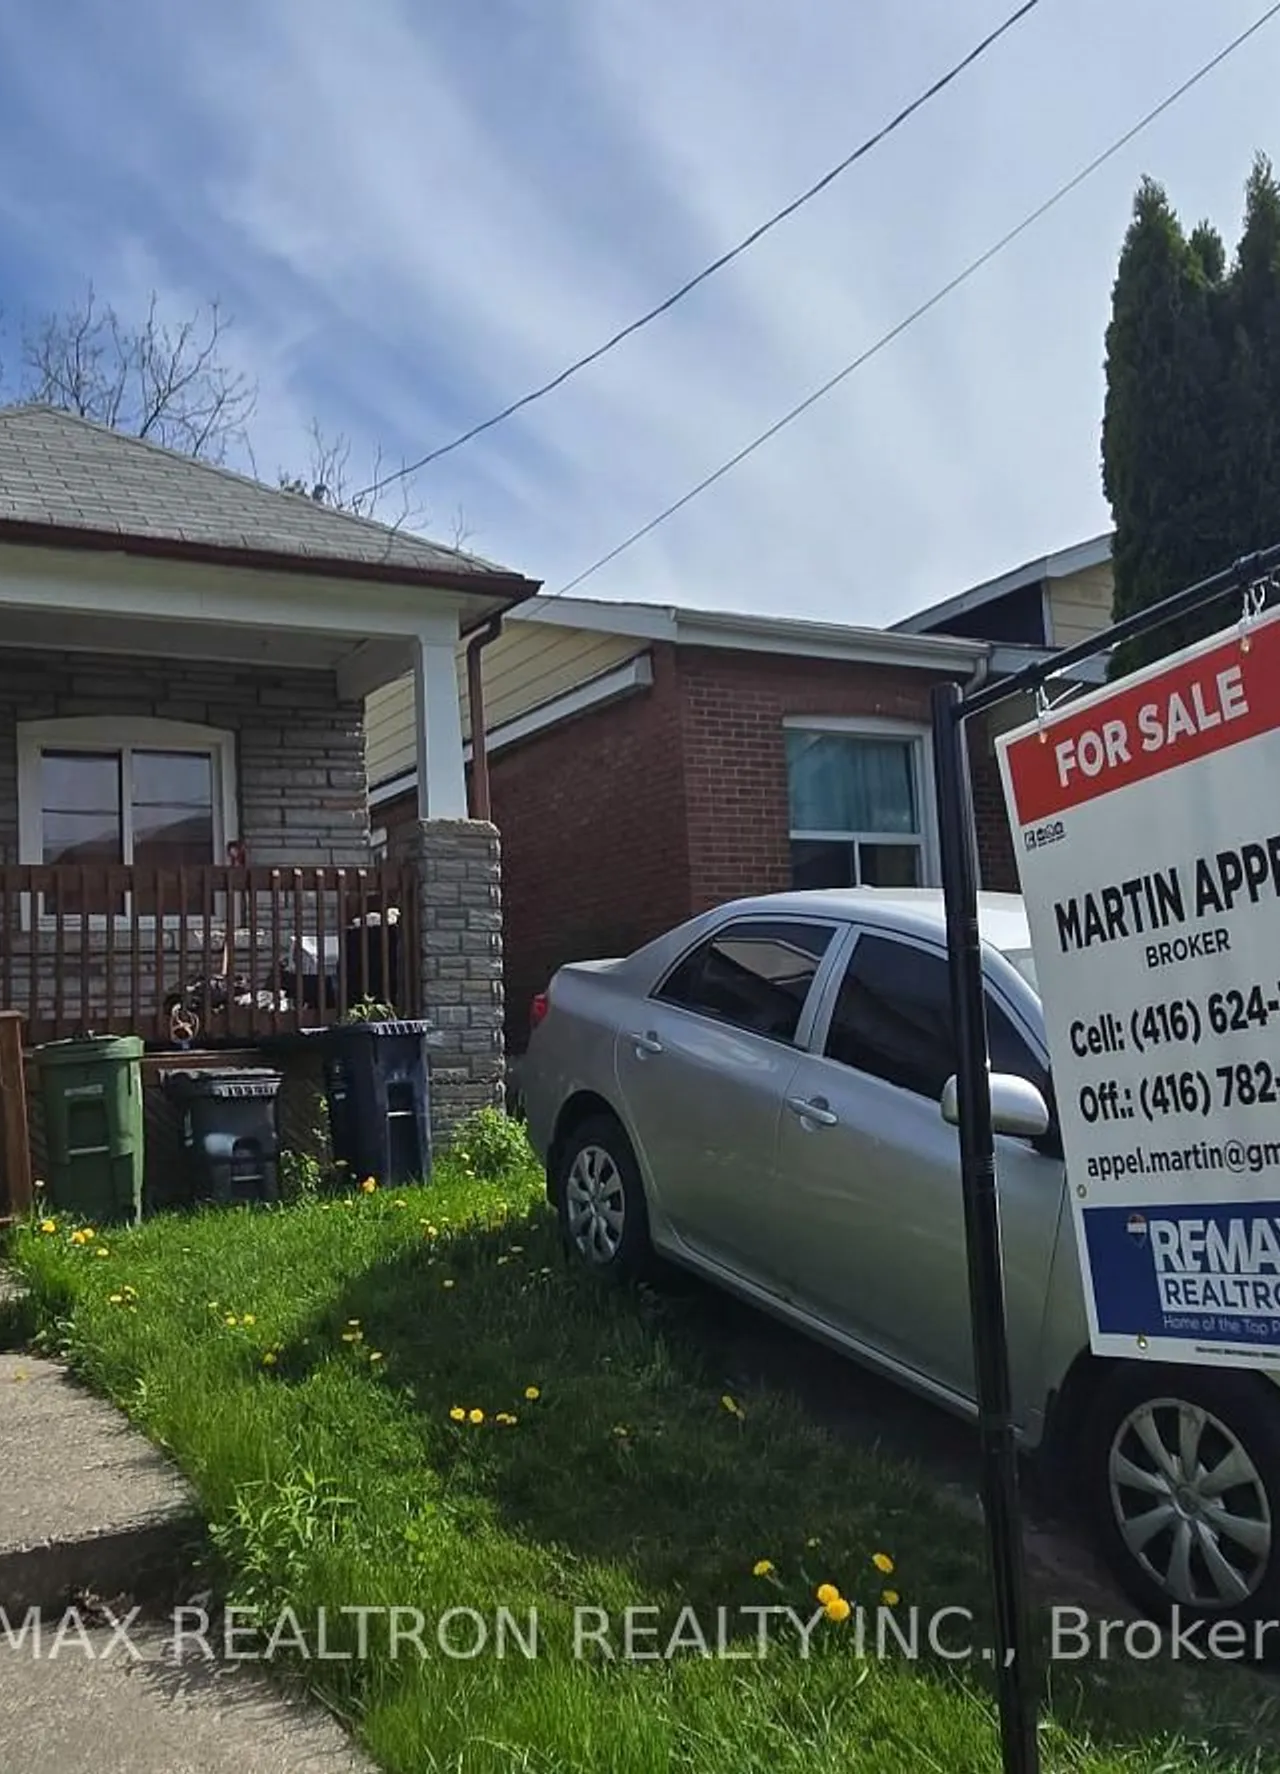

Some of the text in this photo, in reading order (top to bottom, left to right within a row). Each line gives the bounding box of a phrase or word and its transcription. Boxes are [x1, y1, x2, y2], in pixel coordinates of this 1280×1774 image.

[1055, 665, 1250, 787] FOR SALE
[1054, 868, 1184, 953] MARTIN
[1145, 928, 1231, 968] BROKER
[1070, 1015, 1125, 1057] Cell:
[1131, 1001, 1201, 1052] (416)
[1079, 1081, 1134, 1123] Off.:
[1140, 1069, 1211, 1121] (416)
[1163, 1315, 1200, 1330] Home
[1202, 1318, 1216, 1332] of
[1218, 1318, 1242, 1333] the
[1244, 1320, 1269, 1336] Top
